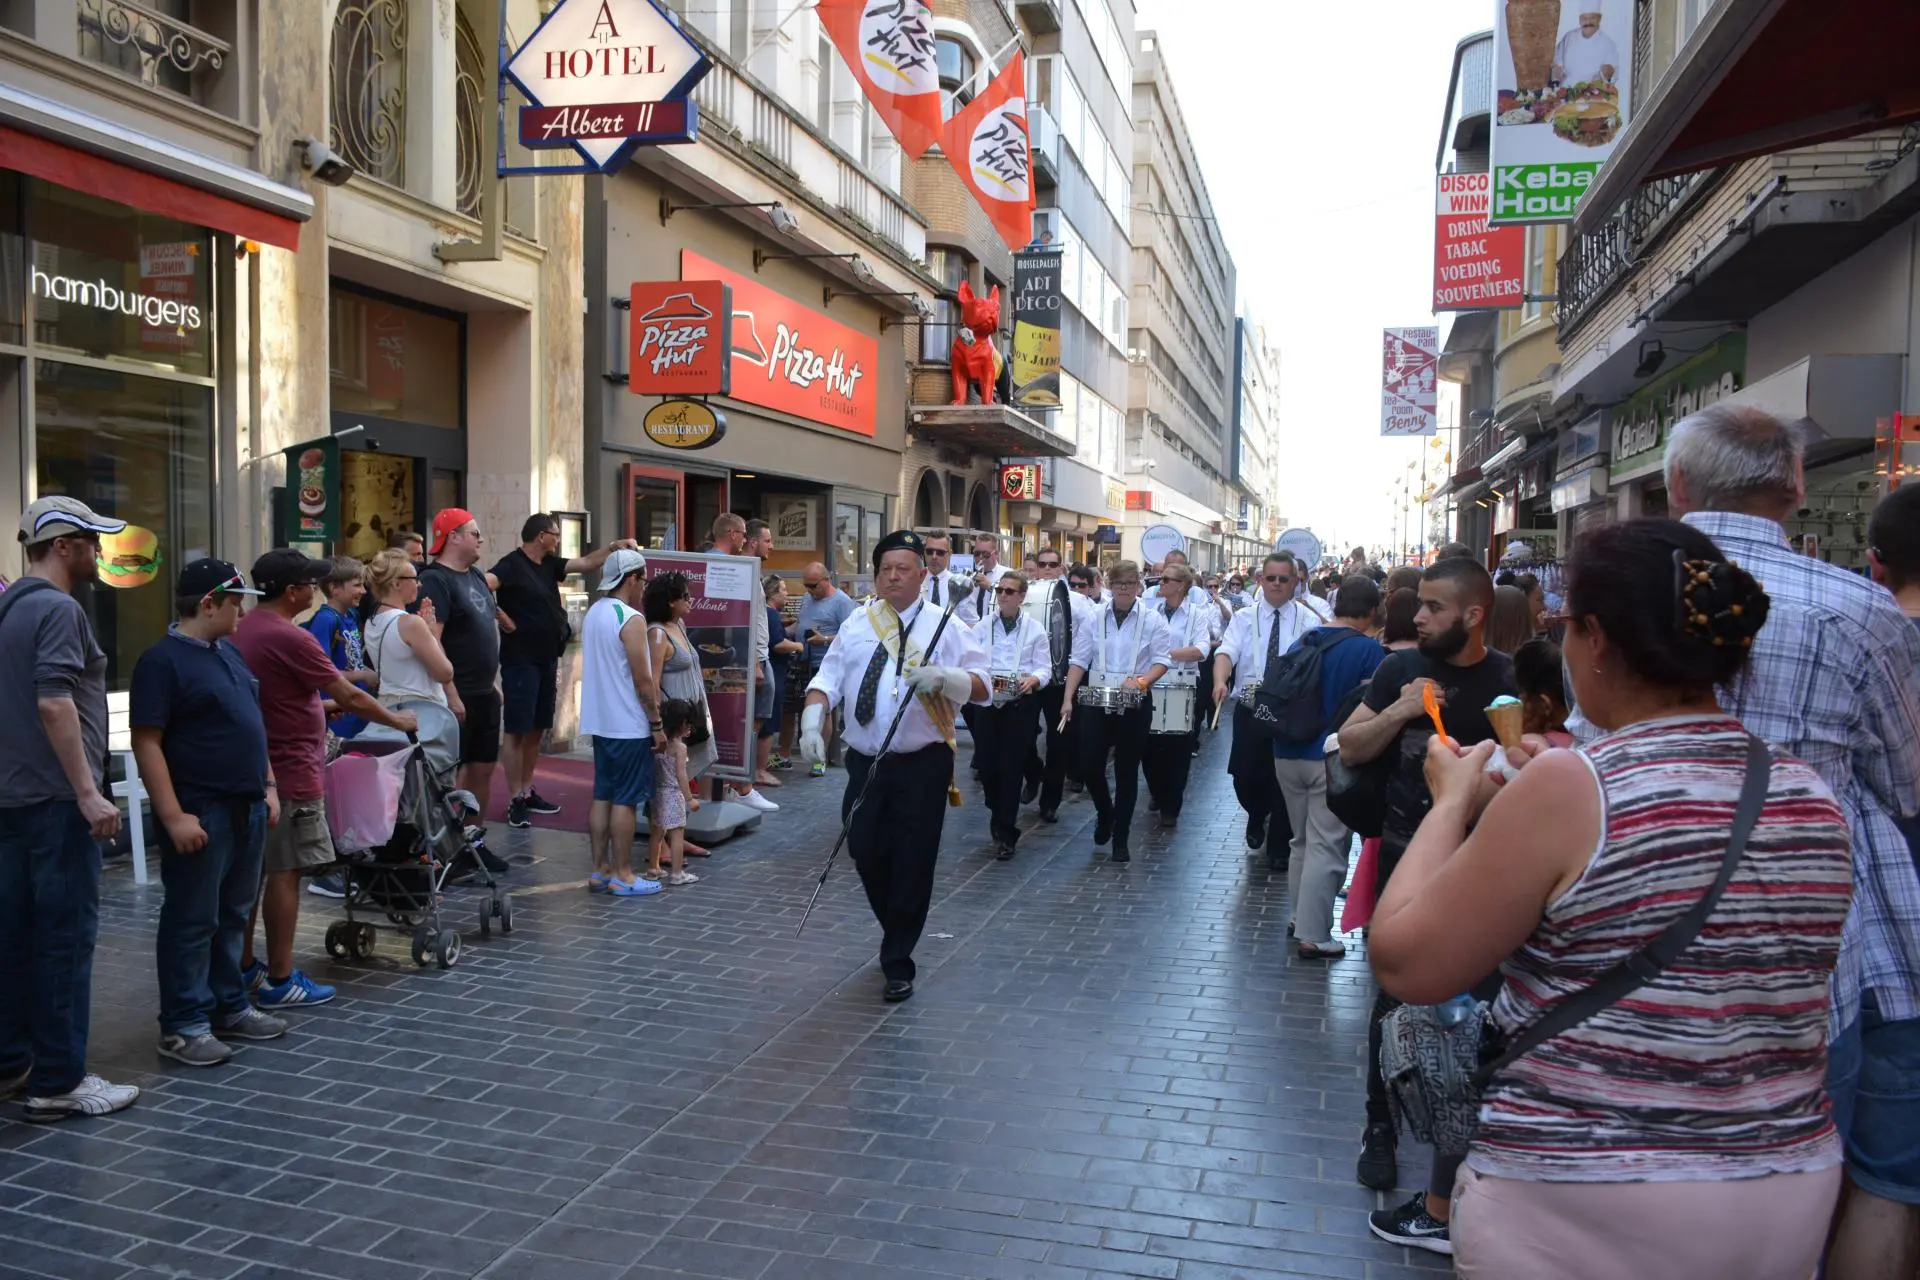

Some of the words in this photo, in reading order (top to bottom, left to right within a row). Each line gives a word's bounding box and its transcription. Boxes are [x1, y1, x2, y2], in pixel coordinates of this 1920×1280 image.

[588, 0, 621, 39] A
[543, 45, 666, 80] HOTEL
[867, 27, 929, 72] Hut
[542, 107, 624, 140] Albert
[976, 147, 1027, 184] Hut
[1497, 164, 1603, 191] Keba
[1444, 239, 1488, 260] TABAC
[1017, 259, 1060, 271] MOSSELPALEIS
[1440, 259, 1501, 282] VOEDING
[31, 264, 201, 329] hamburgers
[1024, 276, 1052, 292] ART
[1436, 278, 1521, 305] SOUVENIERS
[1015, 289, 1061, 312] DECO
[640, 321, 709, 357] Pizza
[651, 345, 705, 376] Hut
[661, 370, 709, 378] RESTAURANT
[767, 322, 826, 389] Pizza
[826, 346, 864, 401] Hut
[820, 395, 858, 418] RESTAURANT
[650, 423, 712, 437] RESTAURANT
[1384, 414, 1428, 434] Benny
[1025, 466, 1034, 496] Jupiler
